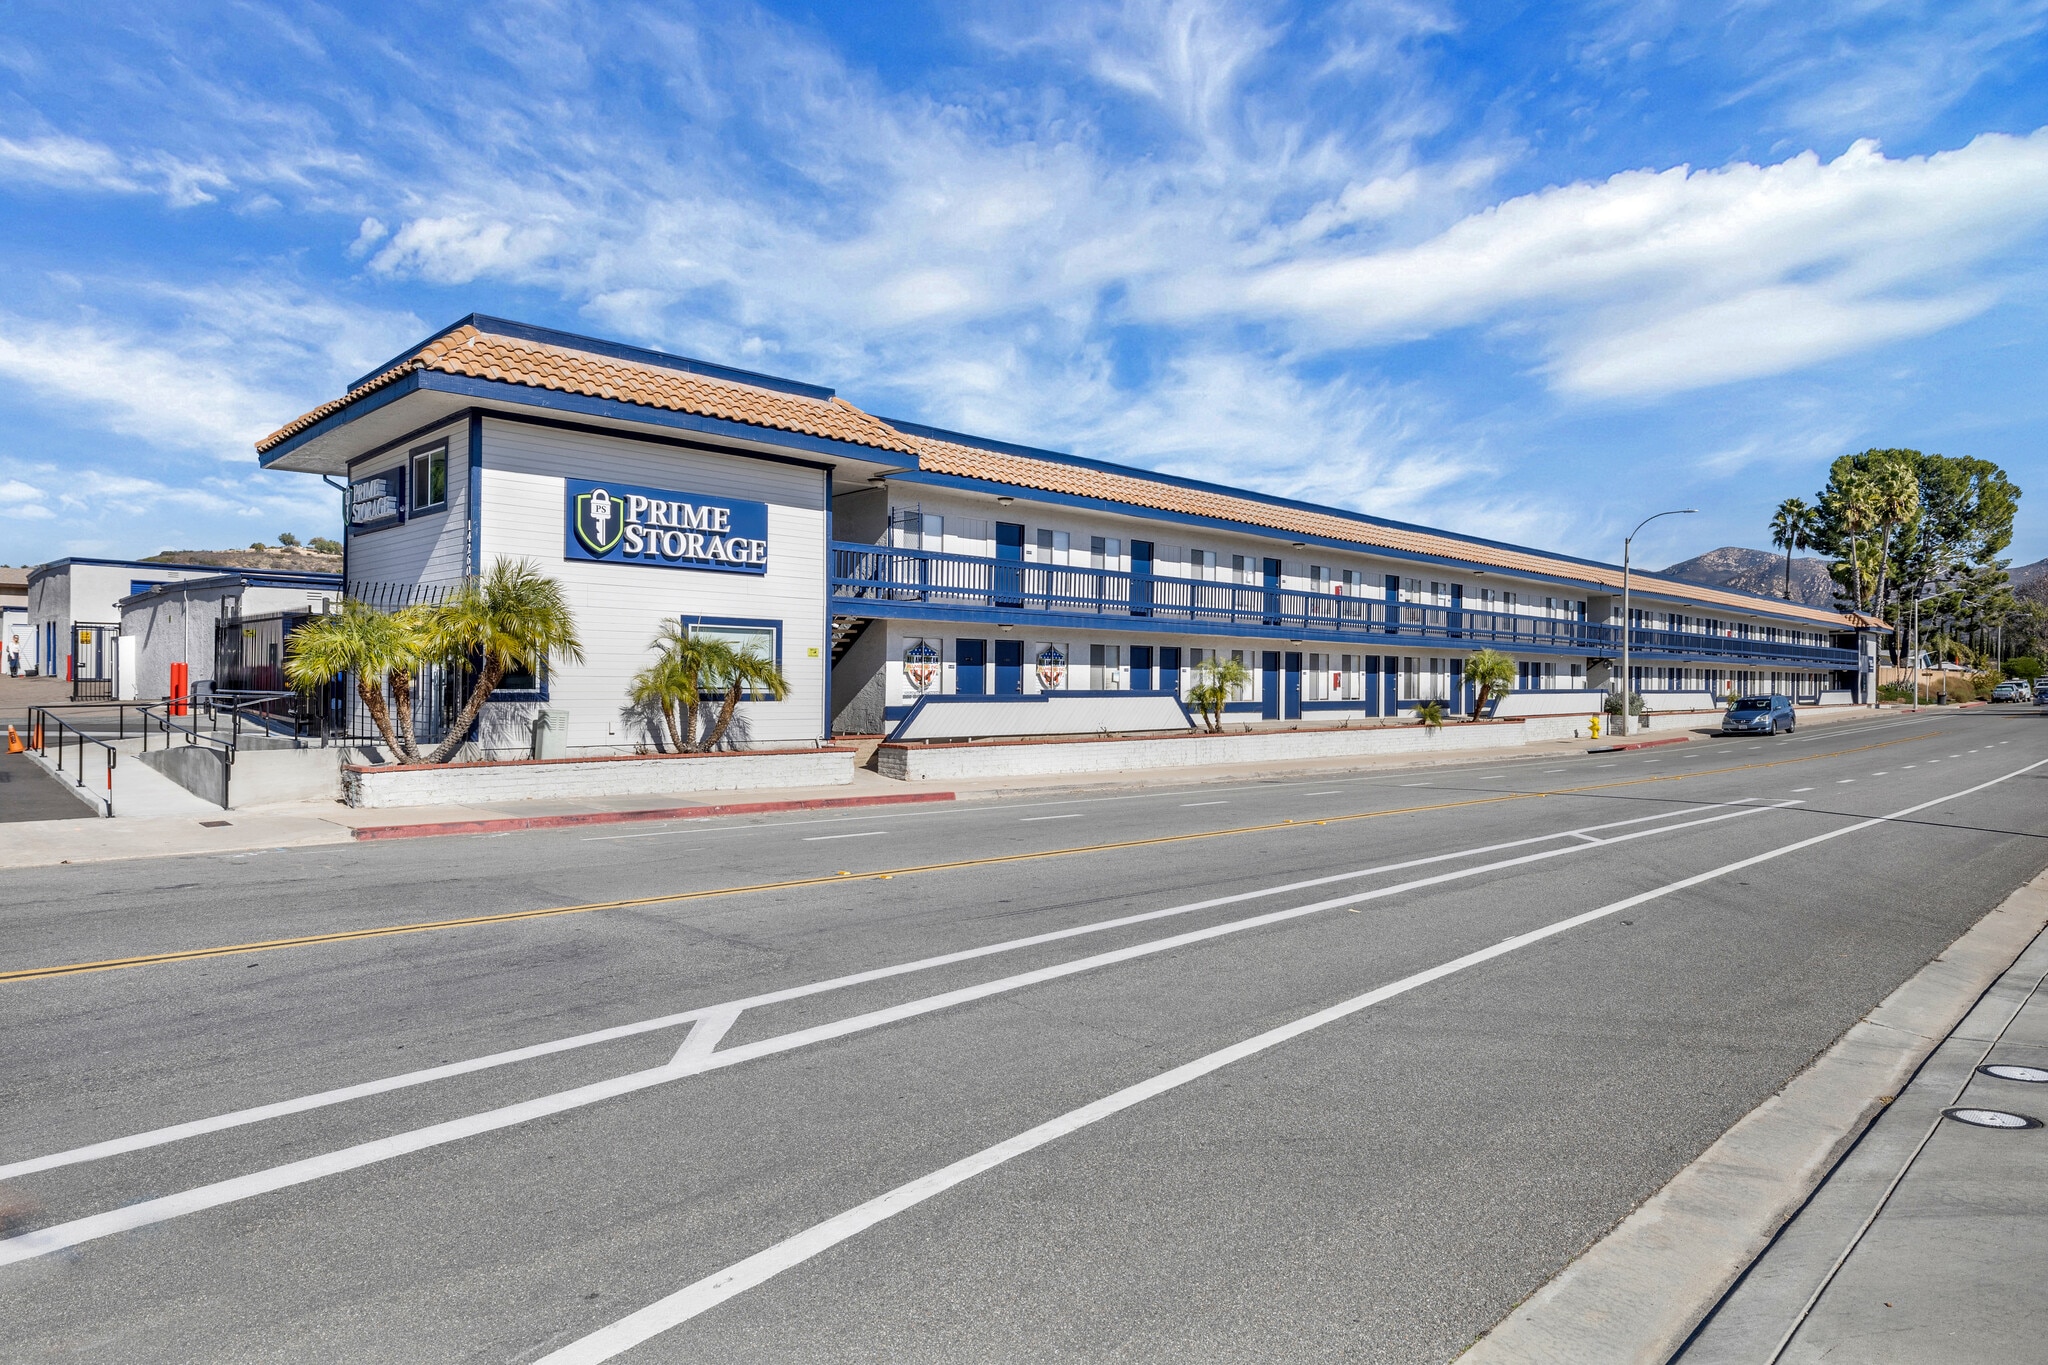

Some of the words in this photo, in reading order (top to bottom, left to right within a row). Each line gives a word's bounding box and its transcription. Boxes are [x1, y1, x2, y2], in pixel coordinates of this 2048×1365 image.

[352, 479, 387, 503] PRIME
[352, 496, 397, 524] STORAGE
[595, 504, 607, 514] PS
[624, 494, 731, 533] PRIME
[623, 524, 768, 564] STORAGE
